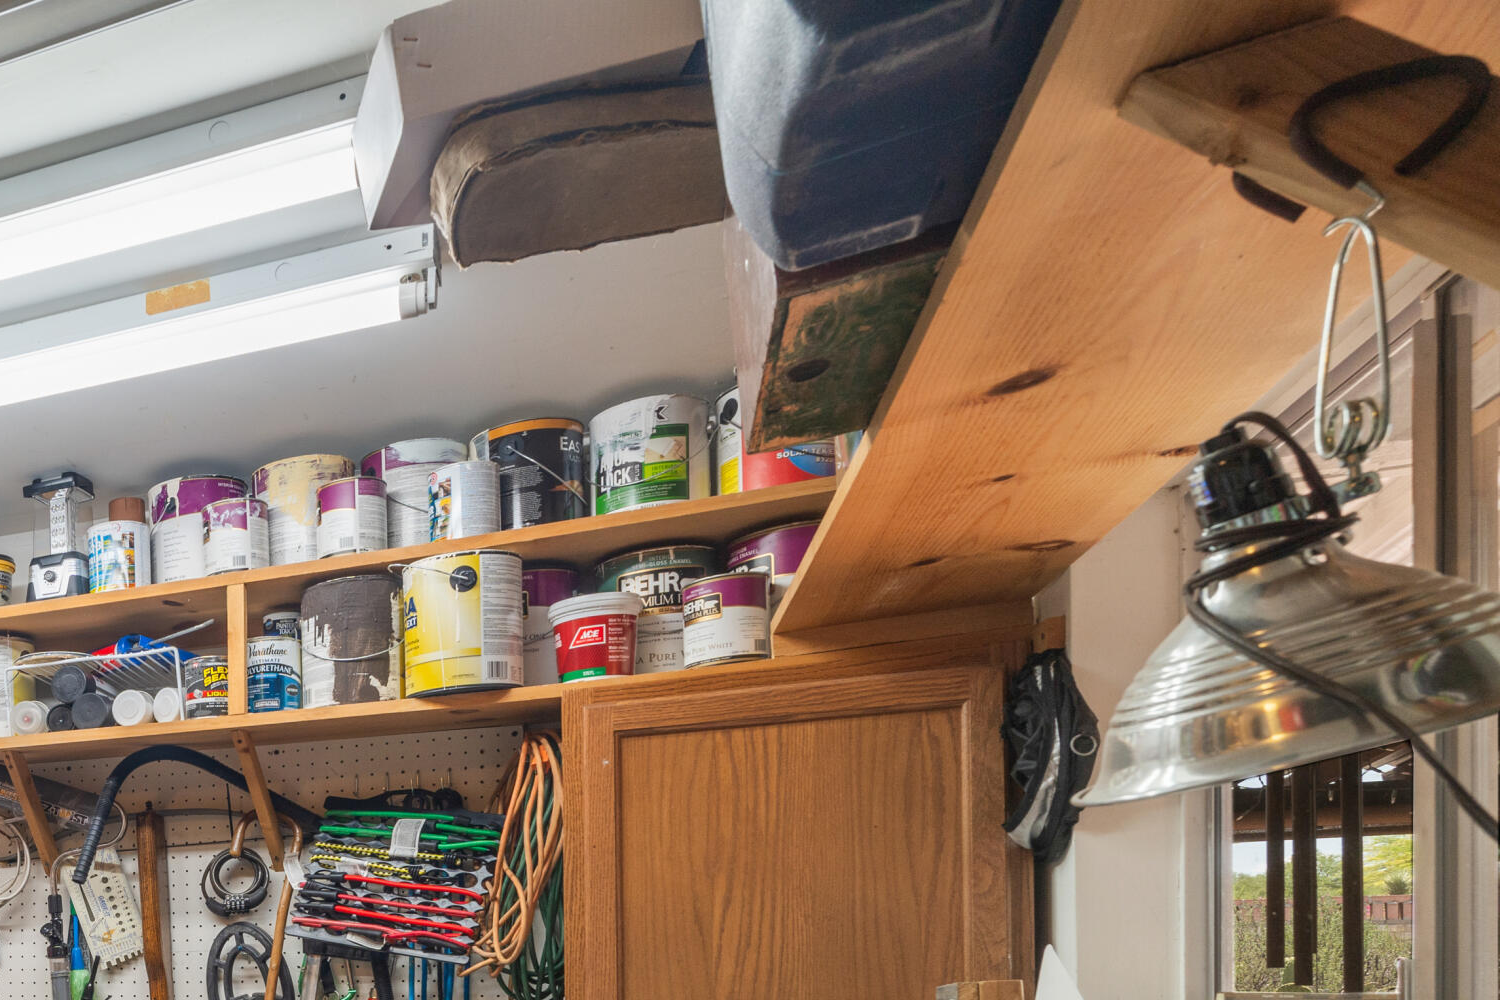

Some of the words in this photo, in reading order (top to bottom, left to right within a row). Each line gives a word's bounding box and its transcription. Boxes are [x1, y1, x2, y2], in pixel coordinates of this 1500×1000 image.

[621, 572, 680, 597] BEHR
[581, 629, 599, 640] ACE
[248, 664, 293, 675] LYURETHANE
[204, 673, 228, 687] SEA
